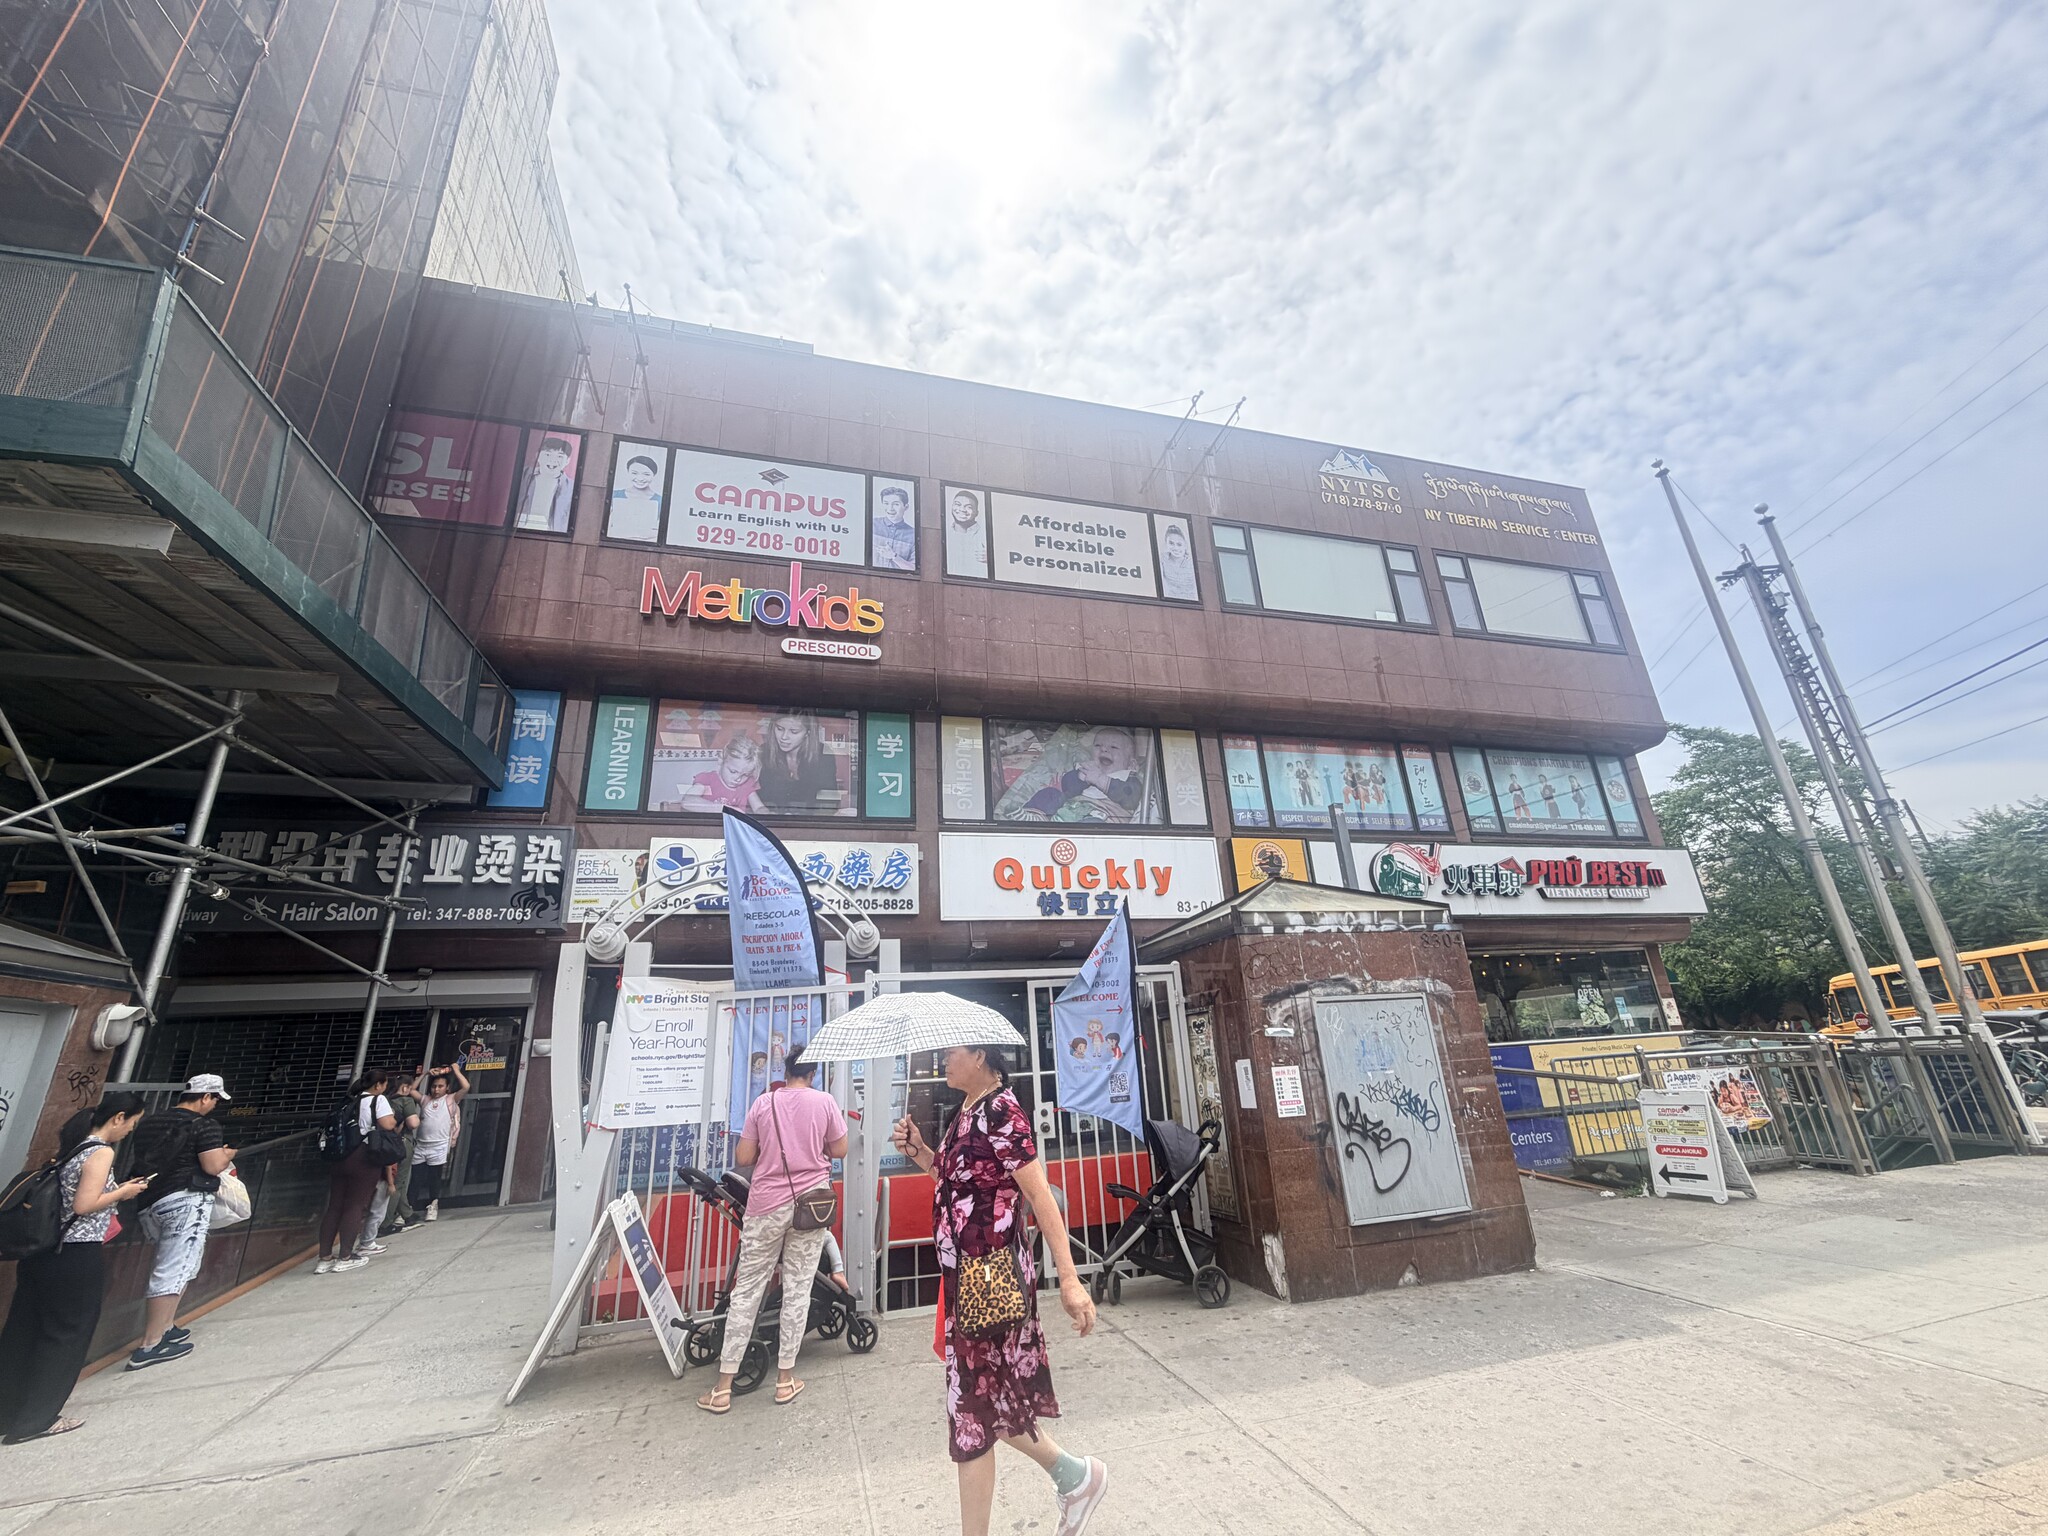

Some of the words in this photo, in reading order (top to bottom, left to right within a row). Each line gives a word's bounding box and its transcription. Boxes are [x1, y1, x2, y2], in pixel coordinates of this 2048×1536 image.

[385, 431, 473, 482] SL
[384, 479, 471, 503] RSES
[1319, 474, 1401, 501] NYTSC
[1321, 491, 1350, 507] (718)
[689, 508, 732, 521] Learn
[738, 513, 791, 528] English
[796, 520, 826, 532] with
[831, 524, 850, 535] Us
[1018, 514, 1126, 539] Affordable
[1424, 509, 1442, 521] NY
[1446, 512, 1498, 531] TIBETAN
[1501, 521, 1550, 538] SERVICE
[697, 525, 840, 557] 929-208-0018
[1035, 535, 1114, 556] Flexible
[1009, 551, 1142, 578] Personalized
[639, 562, 886, 635] Metrokids
[788, 640, 876, 658] PRESCHOOL
[604, 706, 636, 800] LEARNING
[877, 733, 904, 797] 学习
[578, 859, 611, 867] PRE-K
[750, 875, 767, 886] Be
[993, 857, 1173, 895] Quickly
[1588, 861, 1653, 887] BEST
[750, 887, 790, 897] Above
[1544, 887, 1608, 898] VIETNAMESE
[1610, 887, 1650, 898] CUISINE
[280, 902, 323, 921] Hair
[324, 901, 379, 921] Salon
[435, 908, 532, 921] 347-888-7063
[828, 899, 914, 910] 718-205-8828
[1037, 891, 1119, 916] 快可立
[626, 994, 653, 1004] NYC
[654, 994, 689, 1006] Bright
[690, 994, 709, 1004] Sta
[1577, 988, 1600, 997] OPEN
[655, 1018, 694, 1033] Enroll
[631, 1053, 706, 1062] schools.nyc.gov/BrightStar
[1673, 1072, 1696, 1082] Agape
[1510, 1131, 1553, 1146] Centers
